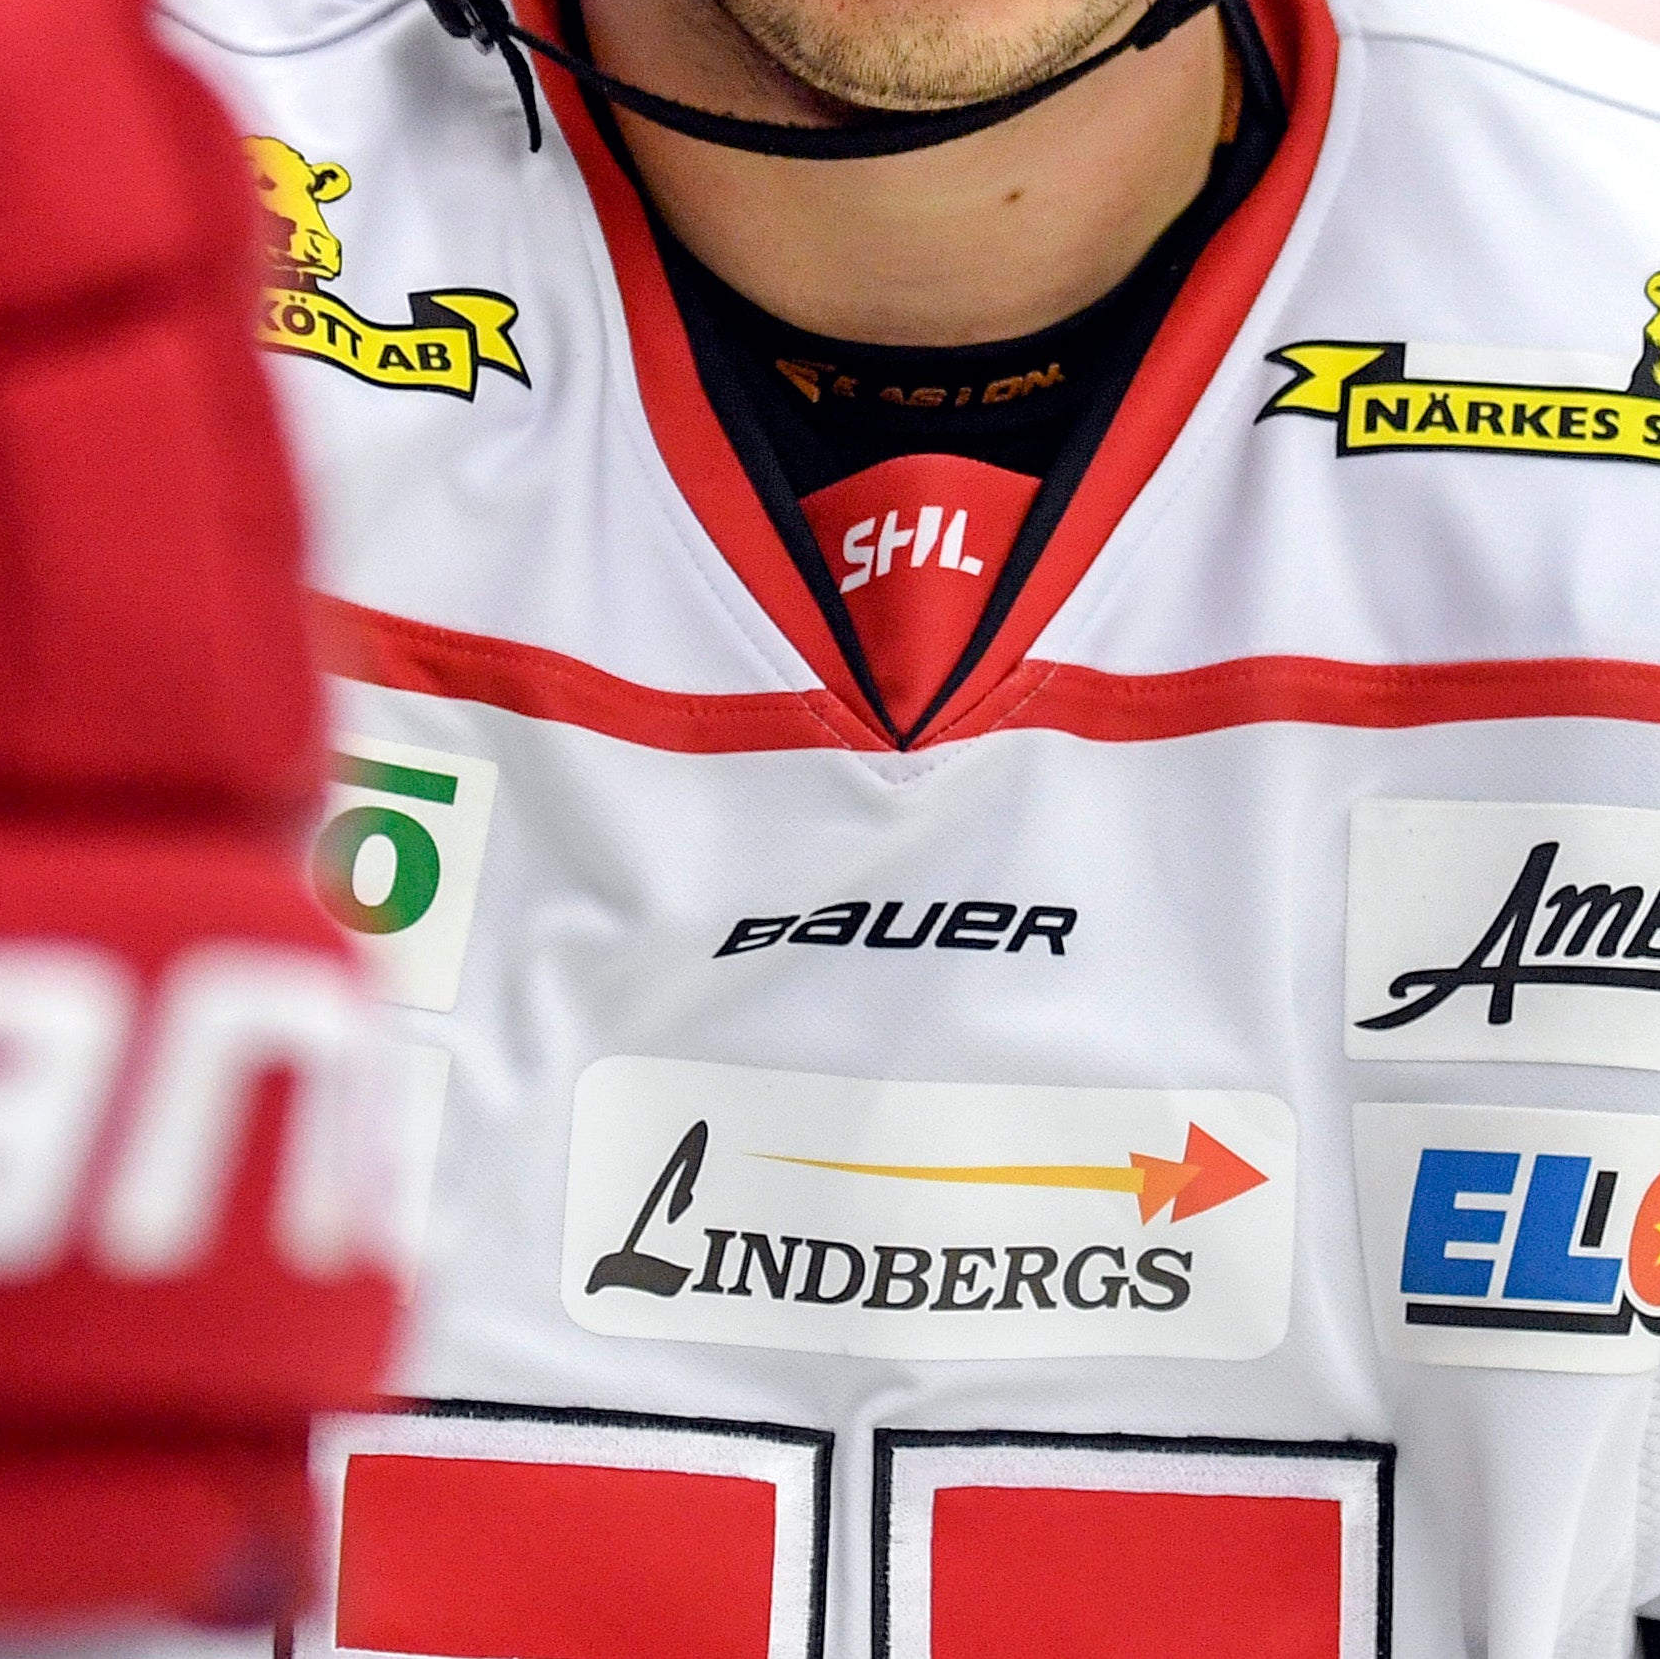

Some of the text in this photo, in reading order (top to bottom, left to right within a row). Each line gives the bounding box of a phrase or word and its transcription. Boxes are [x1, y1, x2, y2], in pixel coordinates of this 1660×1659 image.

[376, 343, 452, 373] AB
[1364, 392, 1620, 441] NÄRKES
[840, 506, 984, 595] SHL
[584, 1119, 1194, 1312] LINDBERGS
